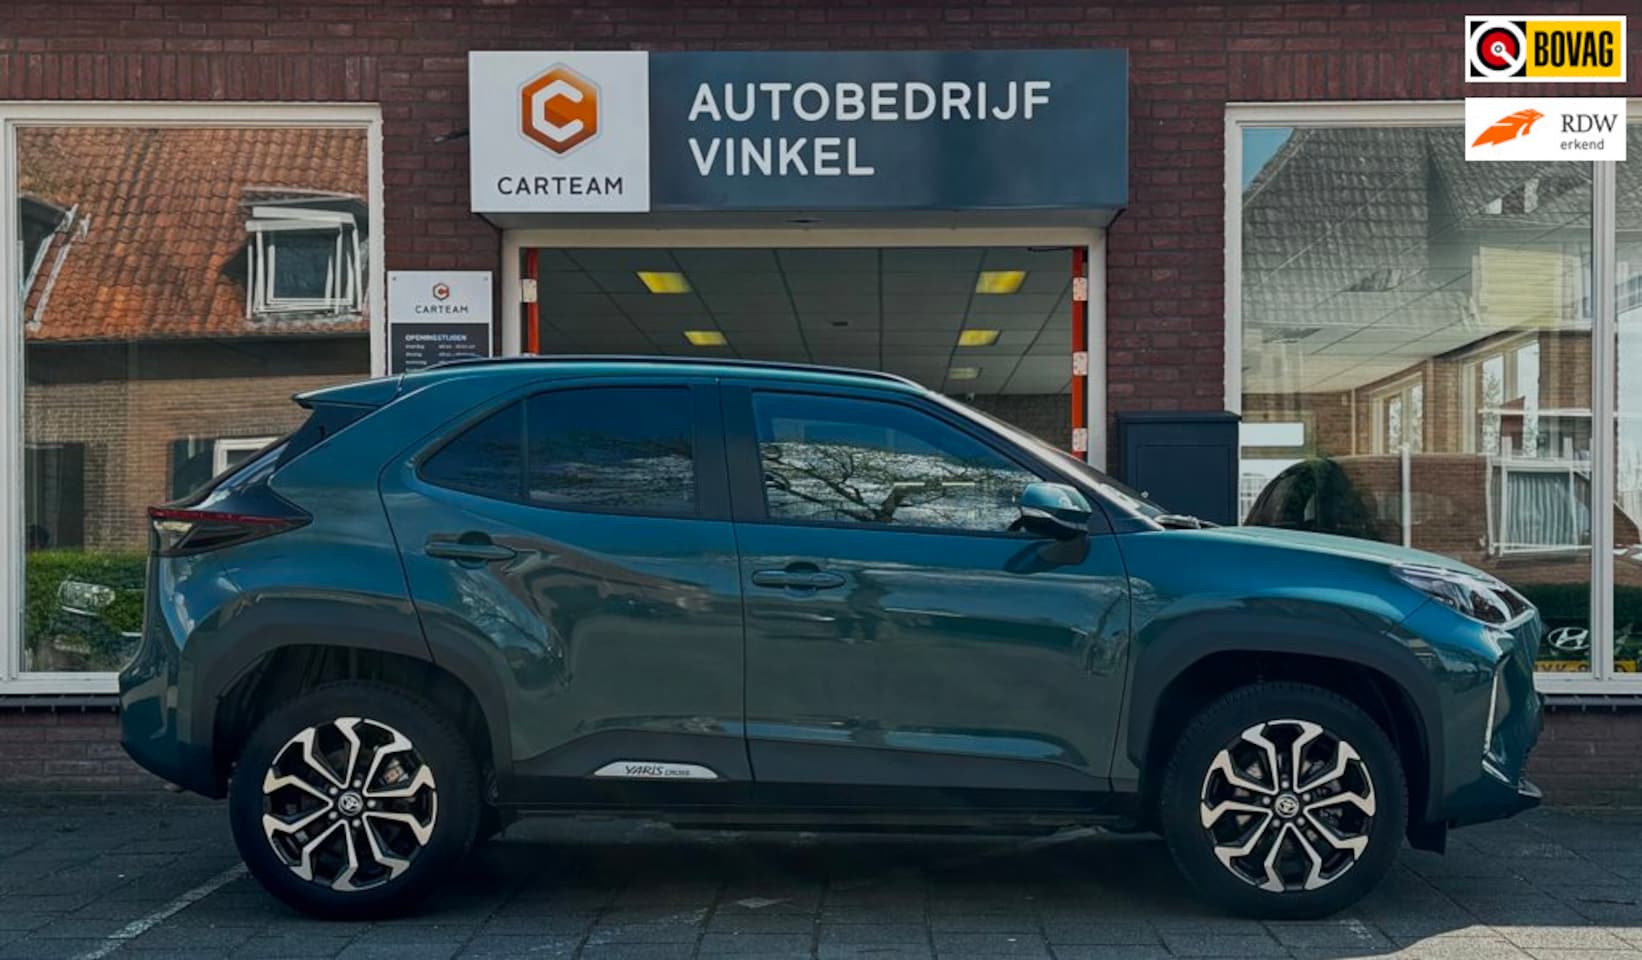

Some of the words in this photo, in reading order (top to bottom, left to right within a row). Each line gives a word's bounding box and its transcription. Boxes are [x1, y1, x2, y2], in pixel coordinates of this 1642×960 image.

[688, 81, 1051, 121] AUTOBEDRIJF
[688, 137, 875, 176] VINKEL
[497, 176, 623, 195] CARTEAM
[415, 304, 469, 314] CARTEAM
[625, 765, 664, 775] YARIS
